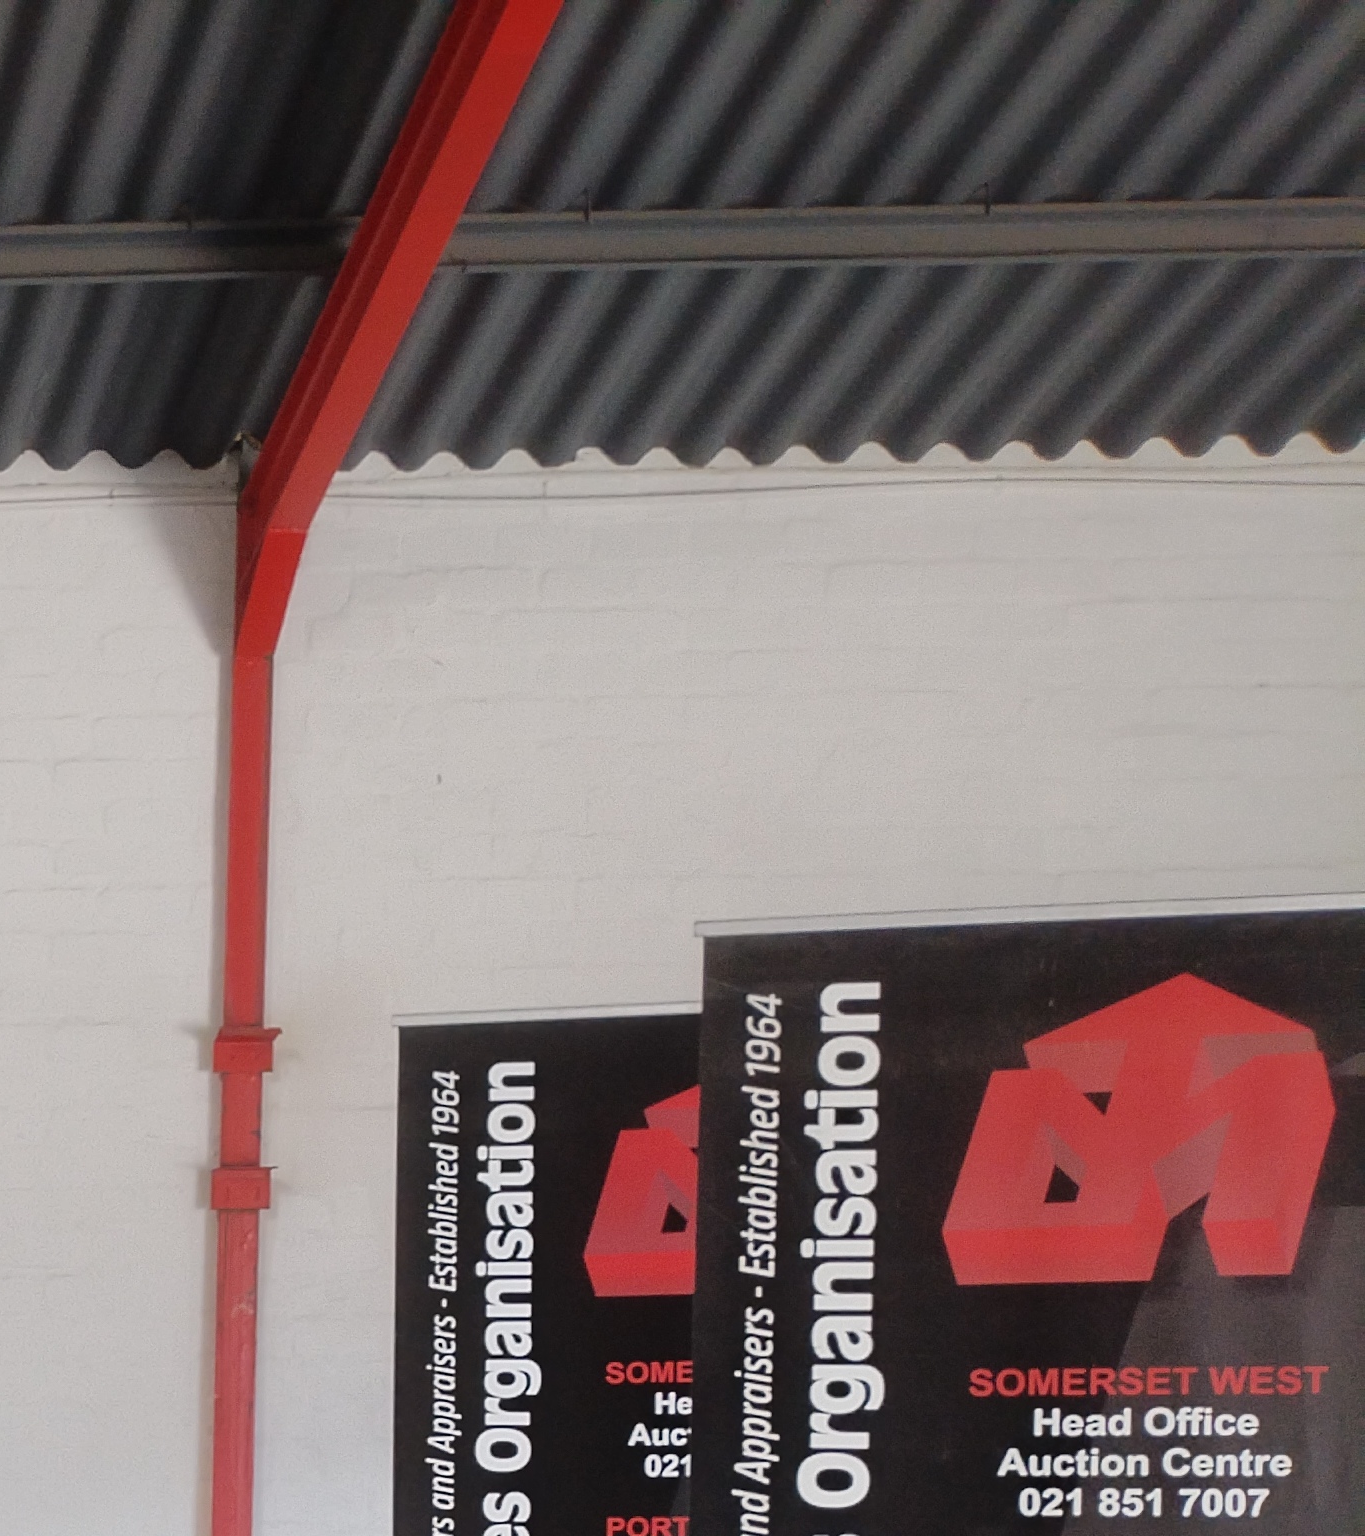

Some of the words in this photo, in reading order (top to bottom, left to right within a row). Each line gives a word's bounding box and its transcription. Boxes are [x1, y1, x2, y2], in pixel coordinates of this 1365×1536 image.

[745, 994, 782, 1075] 1964
[432, 1071, 460, 1135] 1964
[428, 1142, 458, 1291] Established
[738, 1086, 780, 1277] Established
[475, 1062, 541, 1472] Organisation
[797, 982, 885, 1508] Organisation
[425, 1314, 462, 1471] Appraisers
[731, 1307, 780, 1502] Appraisers
[970, 1366, 1198, 1397] SOMERSET
[1209, 1366, 1328, 1395] WEST
[1034, 1407, 1132, 1437] Head
[1144, 1407, 1259, 1436] Office
[425, 1458, 455, 1510] and
[644, 1454, 691, 1477] 021
[997, 1448, 1149, 1477] Auction
[1163, 1448, 1292, 1477] Centre
[1019, 1488, 1082, 1517] 021
[1098, 1488, 1162, 1517] 851
[1179, 1488, 1270, 1517] 7007
